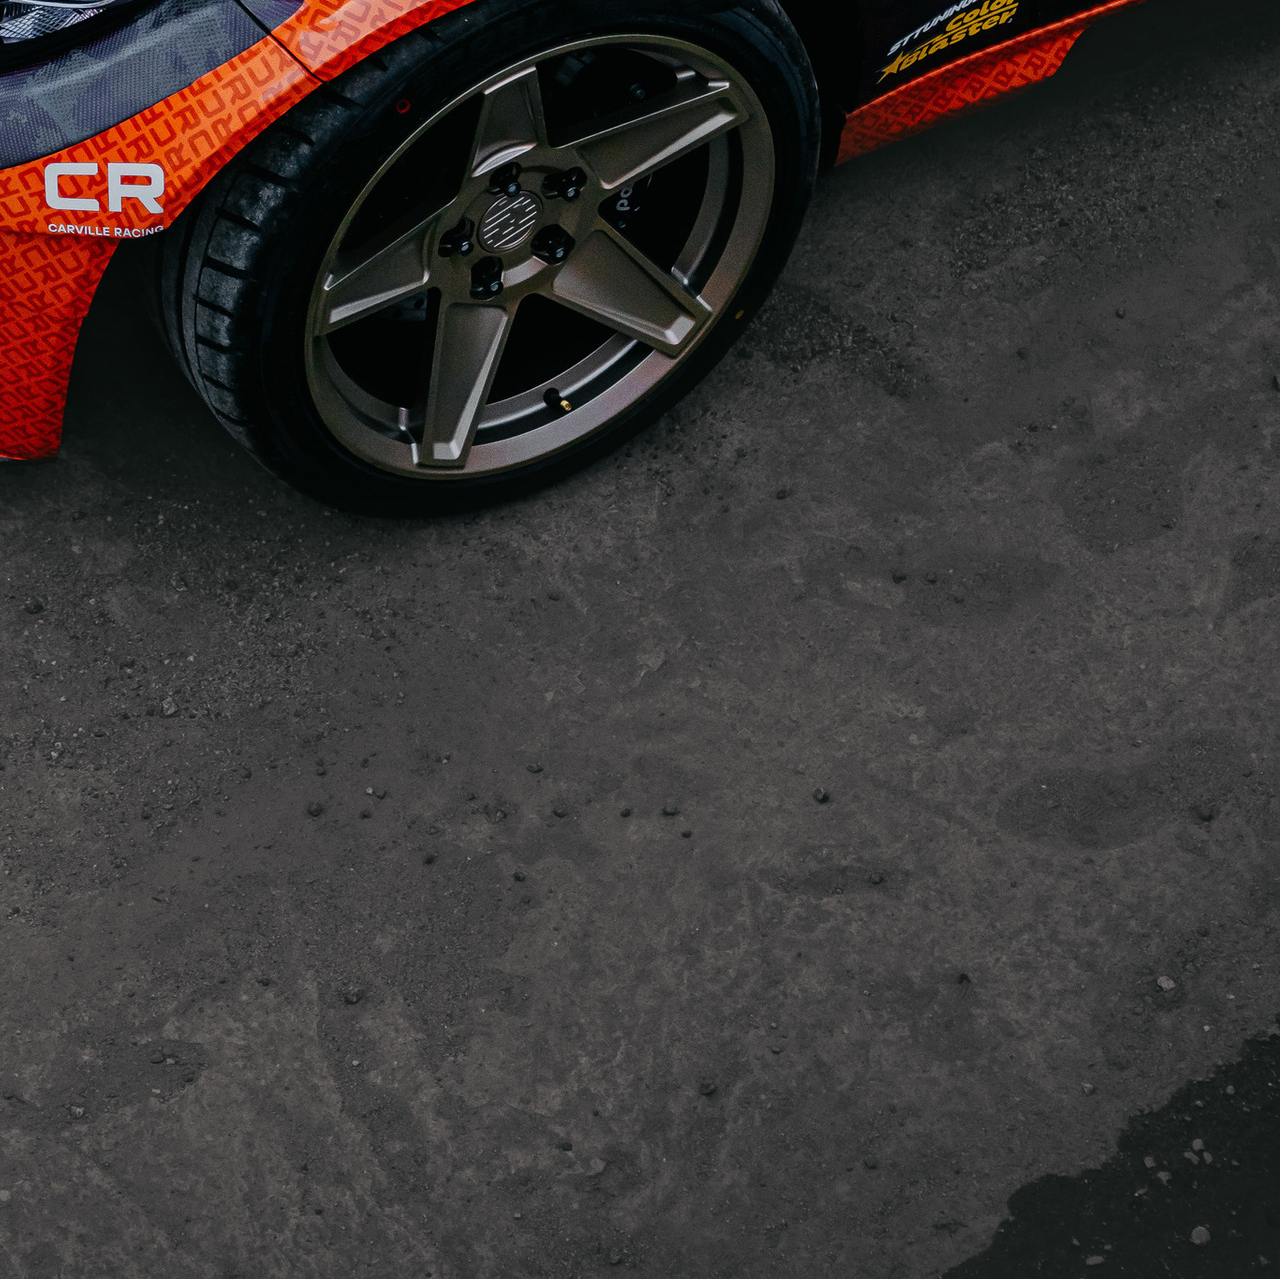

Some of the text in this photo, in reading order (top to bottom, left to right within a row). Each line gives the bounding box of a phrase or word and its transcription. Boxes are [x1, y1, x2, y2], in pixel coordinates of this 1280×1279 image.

[899, 7, 1017, 72] Blaster
[44, 162, 165, 214] CR
[47, 223, 165, 238] CARVILLE RACING
